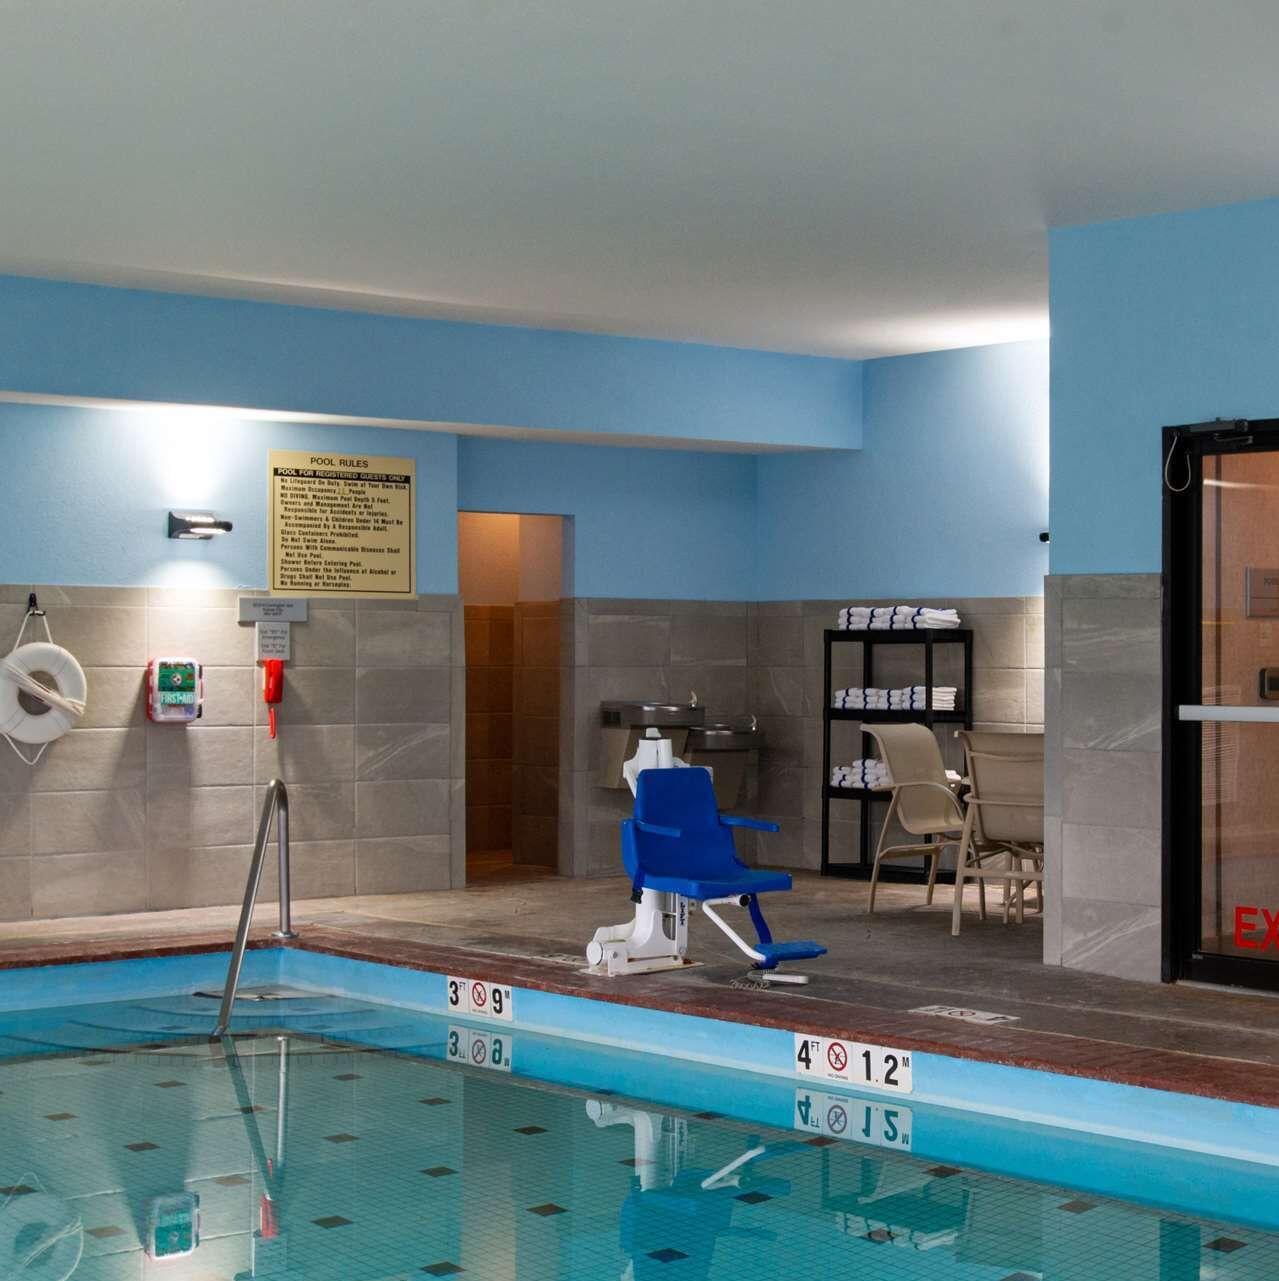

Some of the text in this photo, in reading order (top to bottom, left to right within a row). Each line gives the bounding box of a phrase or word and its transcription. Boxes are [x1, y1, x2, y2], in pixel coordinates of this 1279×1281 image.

[311, 457, 368, 468] POOL RULES
[316, 471, 358, 479] REGISTERED
[290, 478, 316, 486] Lifeguard
[284, 507, 318, 515] Responsible
[338, 524, 371, 532] Responsible
[320, 545, 359, 553] Communicable
[449, 980, 510, 1014] 3 FT 9 M
[797, 1039, 811, 1070] 4
[811, 1041, 820, 1052] FT
[902, 1056, 910, 1068] M
